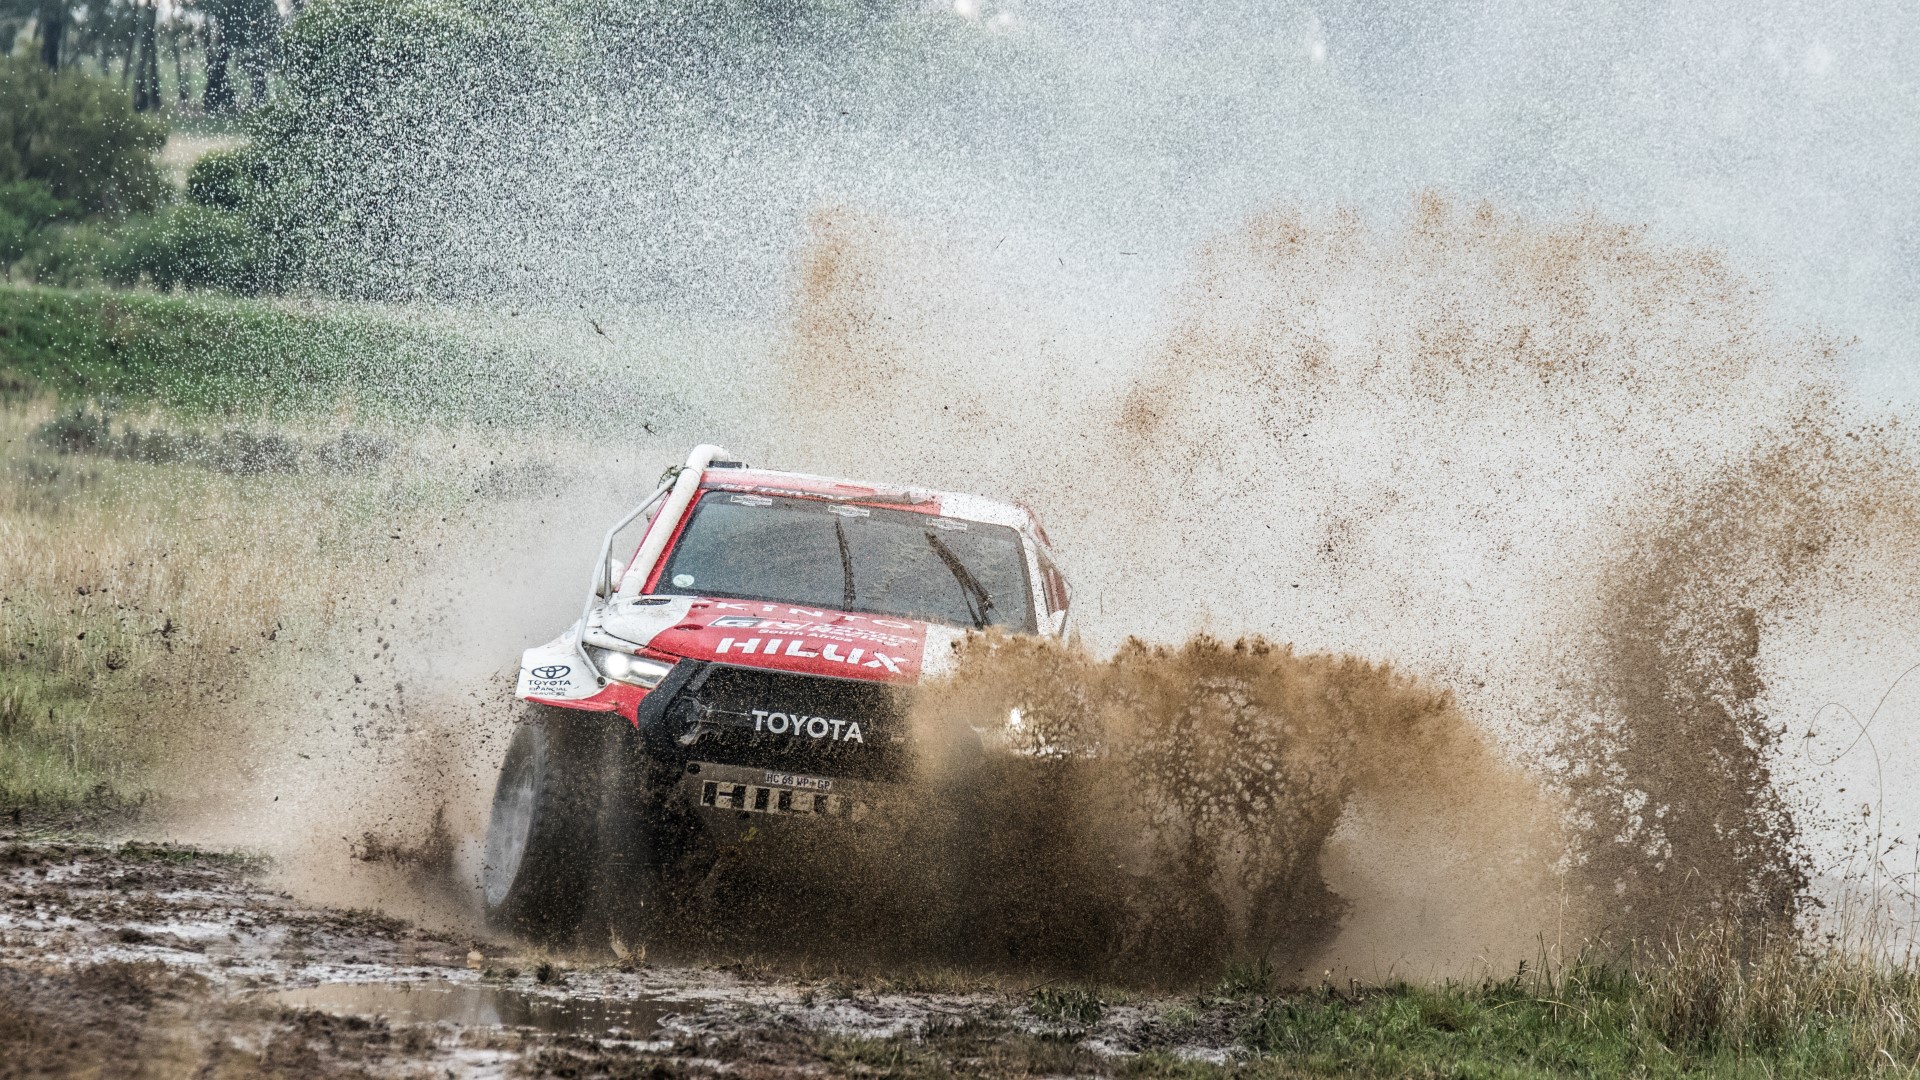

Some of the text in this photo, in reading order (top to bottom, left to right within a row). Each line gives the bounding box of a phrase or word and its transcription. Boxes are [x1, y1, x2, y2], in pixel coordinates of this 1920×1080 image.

[715, 602, 913, 630] KINTO
[759, 629, 853, 643] South Africa
[715, 638, 911, 674] HILUX
[528, 679, 571, 687] TOYOTA
[751, 709, 864, 744] TOYOTA
